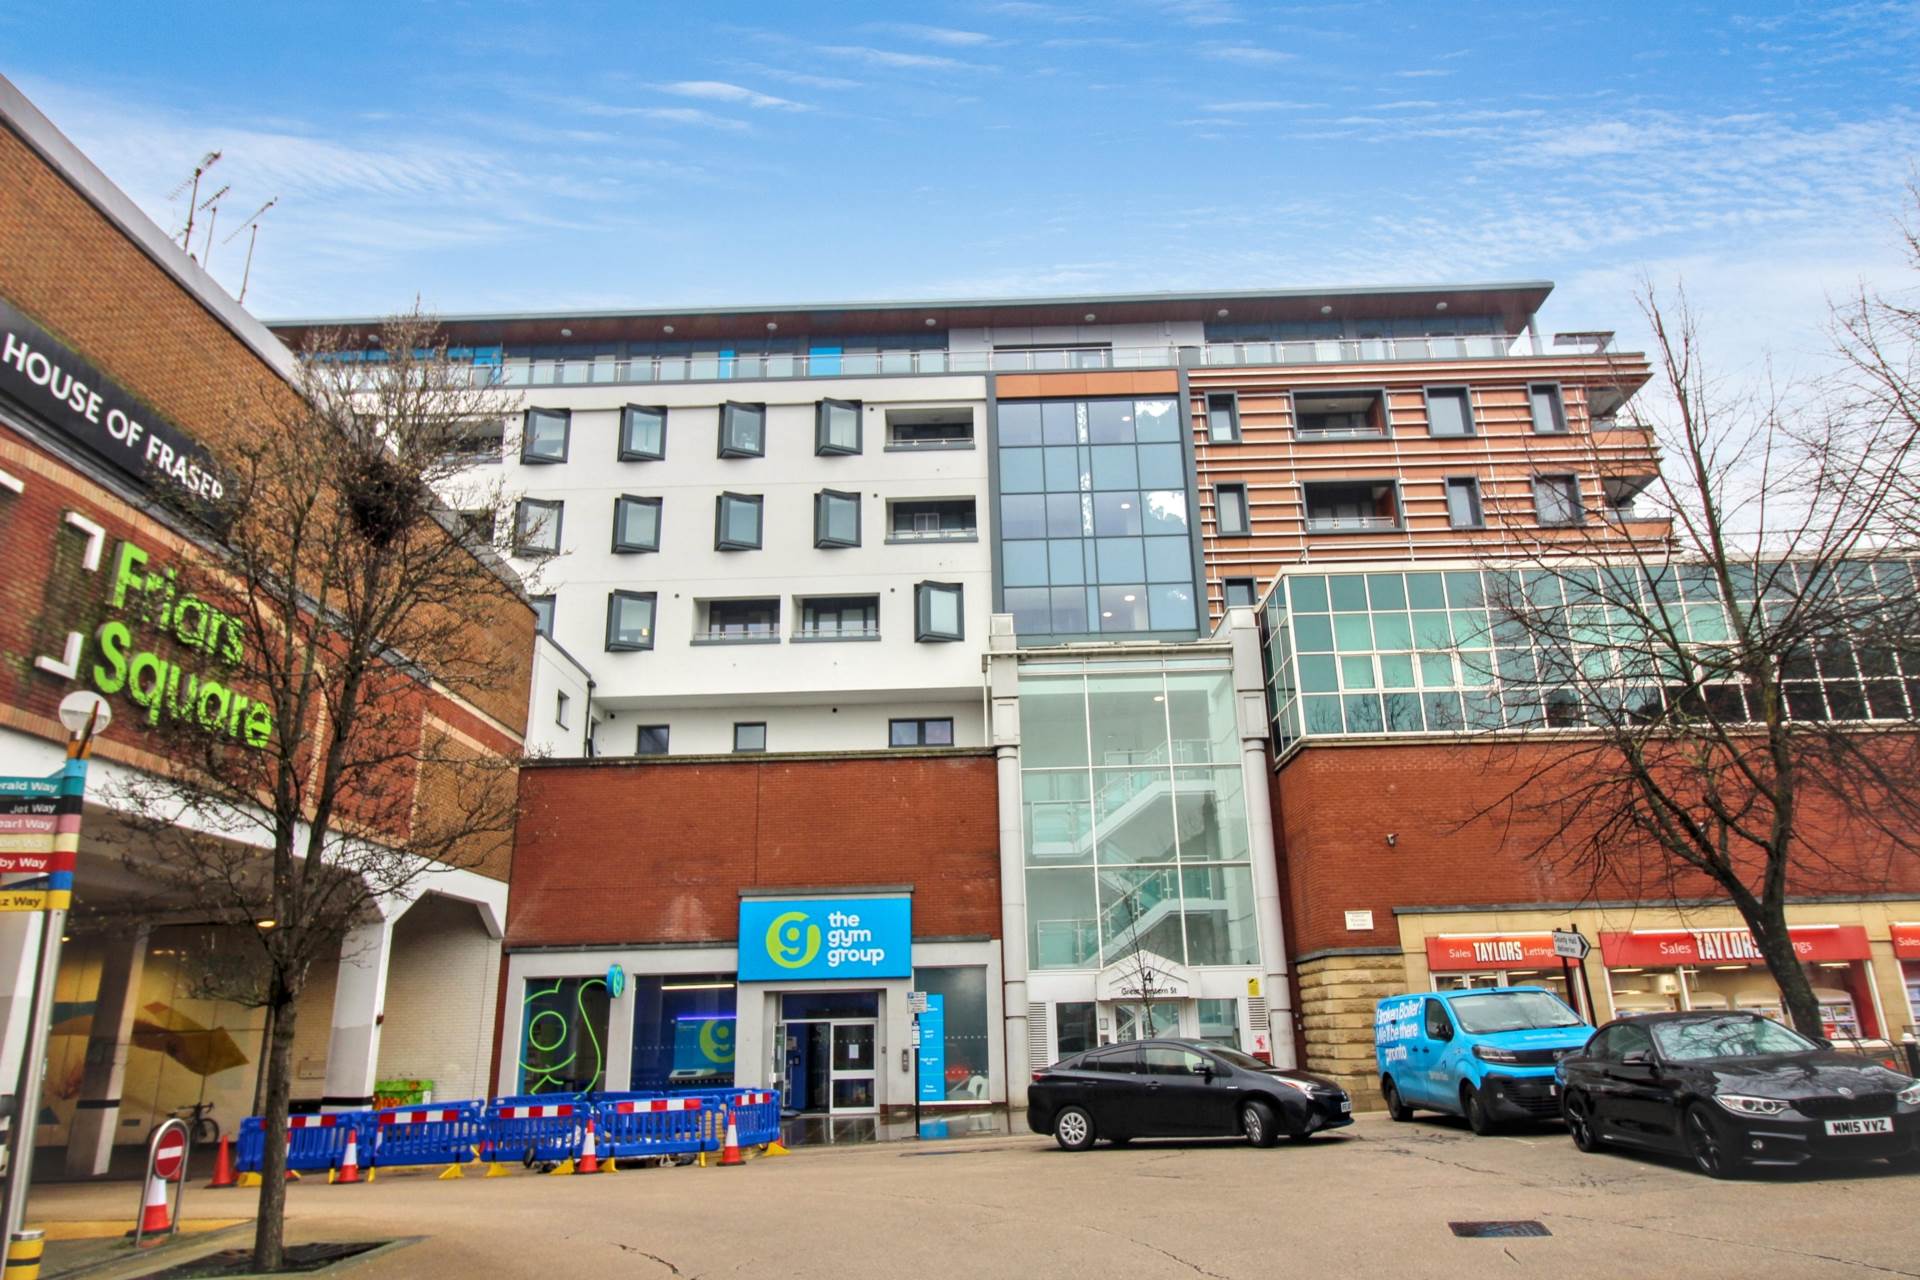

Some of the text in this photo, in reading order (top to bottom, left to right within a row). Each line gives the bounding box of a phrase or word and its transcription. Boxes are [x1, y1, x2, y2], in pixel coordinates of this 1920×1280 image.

[2, 332, 224, 500] HOUSE OF FRASER
[111, 541, 245, 665] Friars
[93, 621, 273, 748] Square
[31, 781, 58, 793] Way
[10, 803, 56, 814] Jet Way
[25, 819, 53, 831] Way
[19, 858, 47, 870] Way
[14, 896, 41, 907] Way
[828, 911, 860, 927] the
[828, 929, 872, 948] gym
[1659, 941, 1692, 954] Sales
[828, 948, 885, 967] group
[1449, 948, 1472, 958] Sales
[1472, 941, 1523, 962] TAYLORS
[1144, 970, 1154, 983] 4
[1377, 996, 1425, 1025] Broken Boiler?
[1391, 1024, 1399, 1041] be
[1400, 1021, 1418, 1039] there
[1385, 1043, 1407, 1066] pronto
